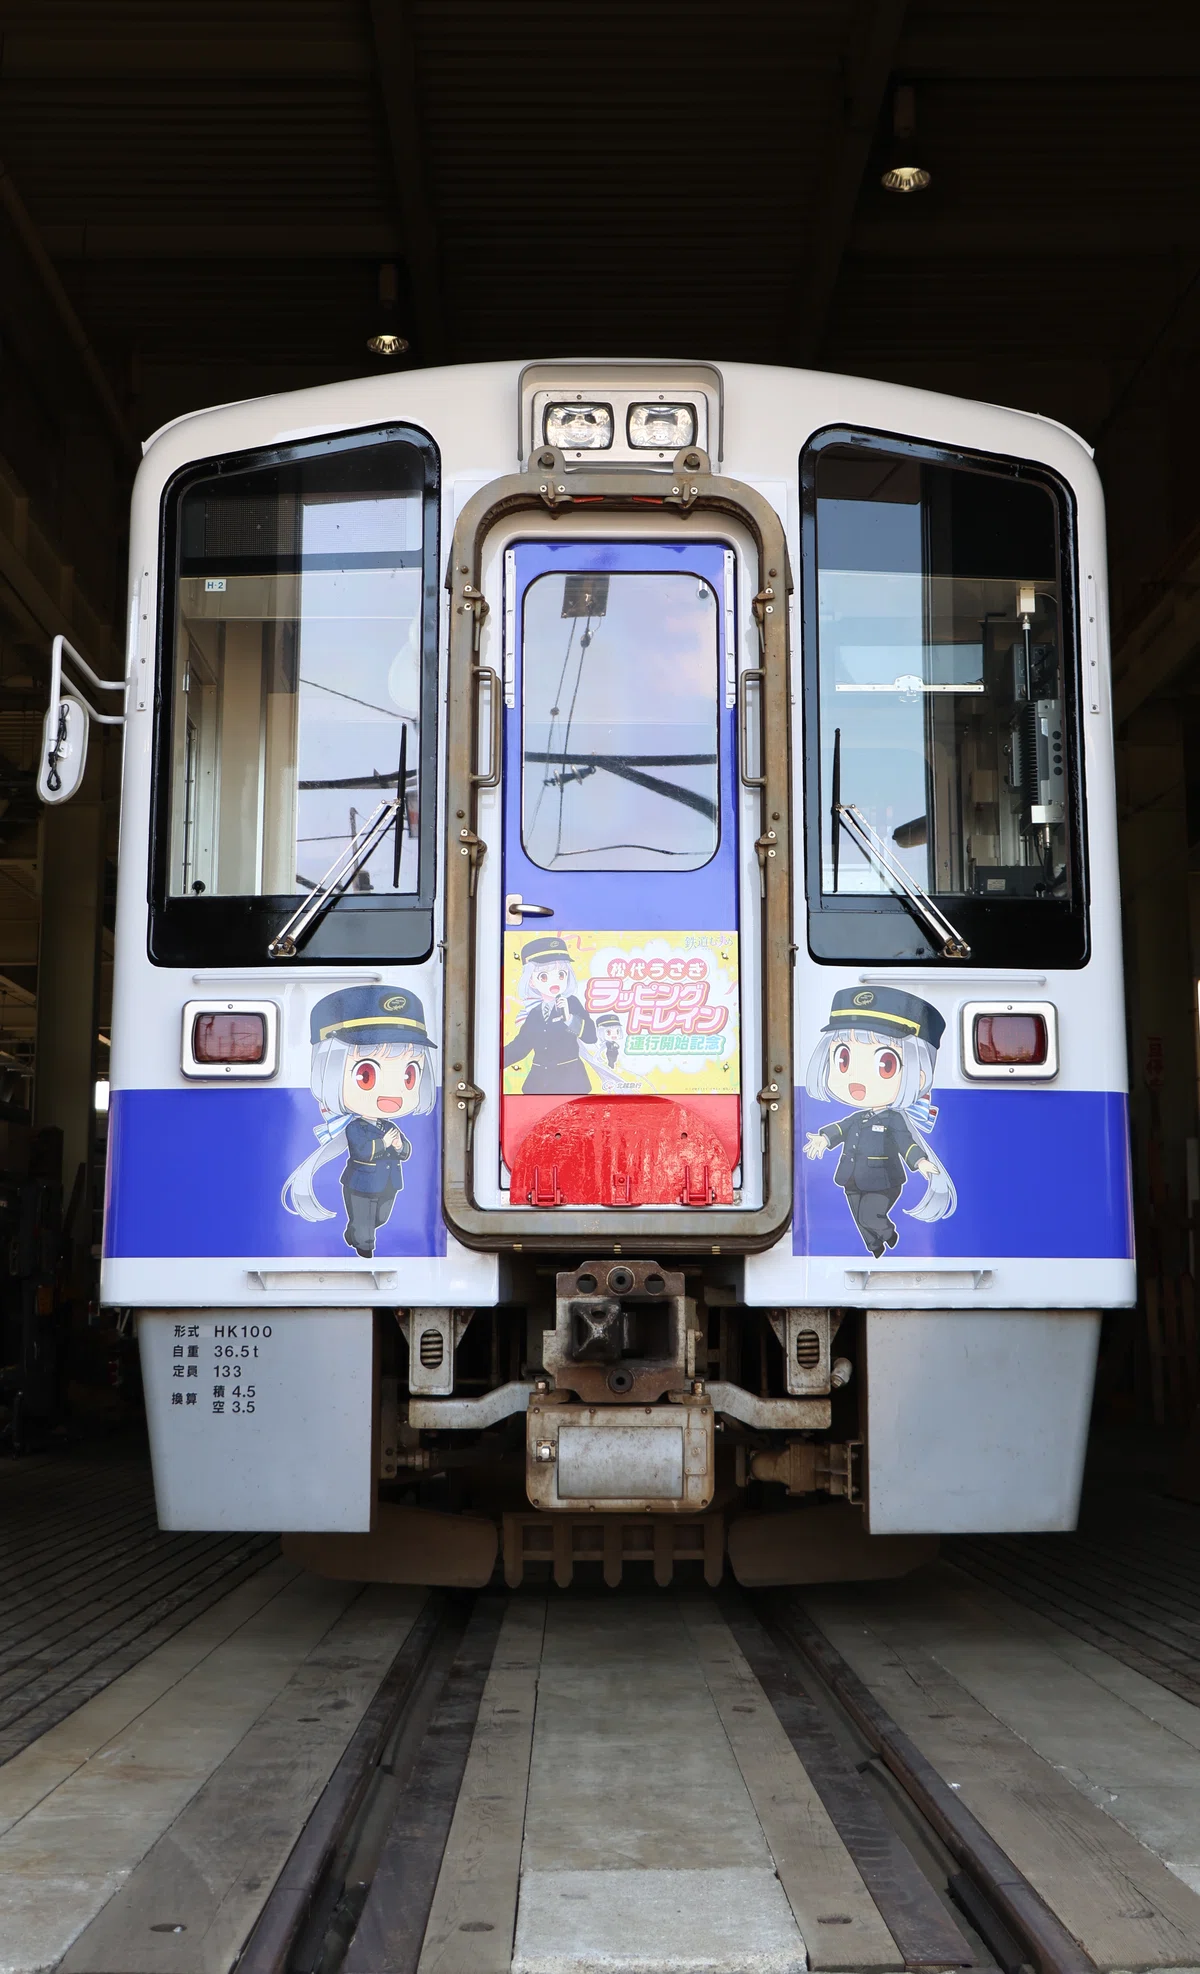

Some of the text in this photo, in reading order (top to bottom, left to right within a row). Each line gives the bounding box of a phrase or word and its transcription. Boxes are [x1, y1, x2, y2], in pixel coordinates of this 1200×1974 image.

[608, 960, 706, 979] 松代うさぎ
[588, 979, 708, 1010] ラッピング
[630, 1006, 725, 1032] トレイン
[628, 1035, 723, 1052] 運行開始記念
[173, 1324, 273, 1339] 形式 HK100
[172, 1344, 259, 1358] 自重 36.5t
[172, 1364, 242, 1378] 定員 133
[212, 1385, 256, 1398] 積 4.5
[171, 1392, 198, 1406] 換算
[212, 1400, 256, 1414] 空 3.5
